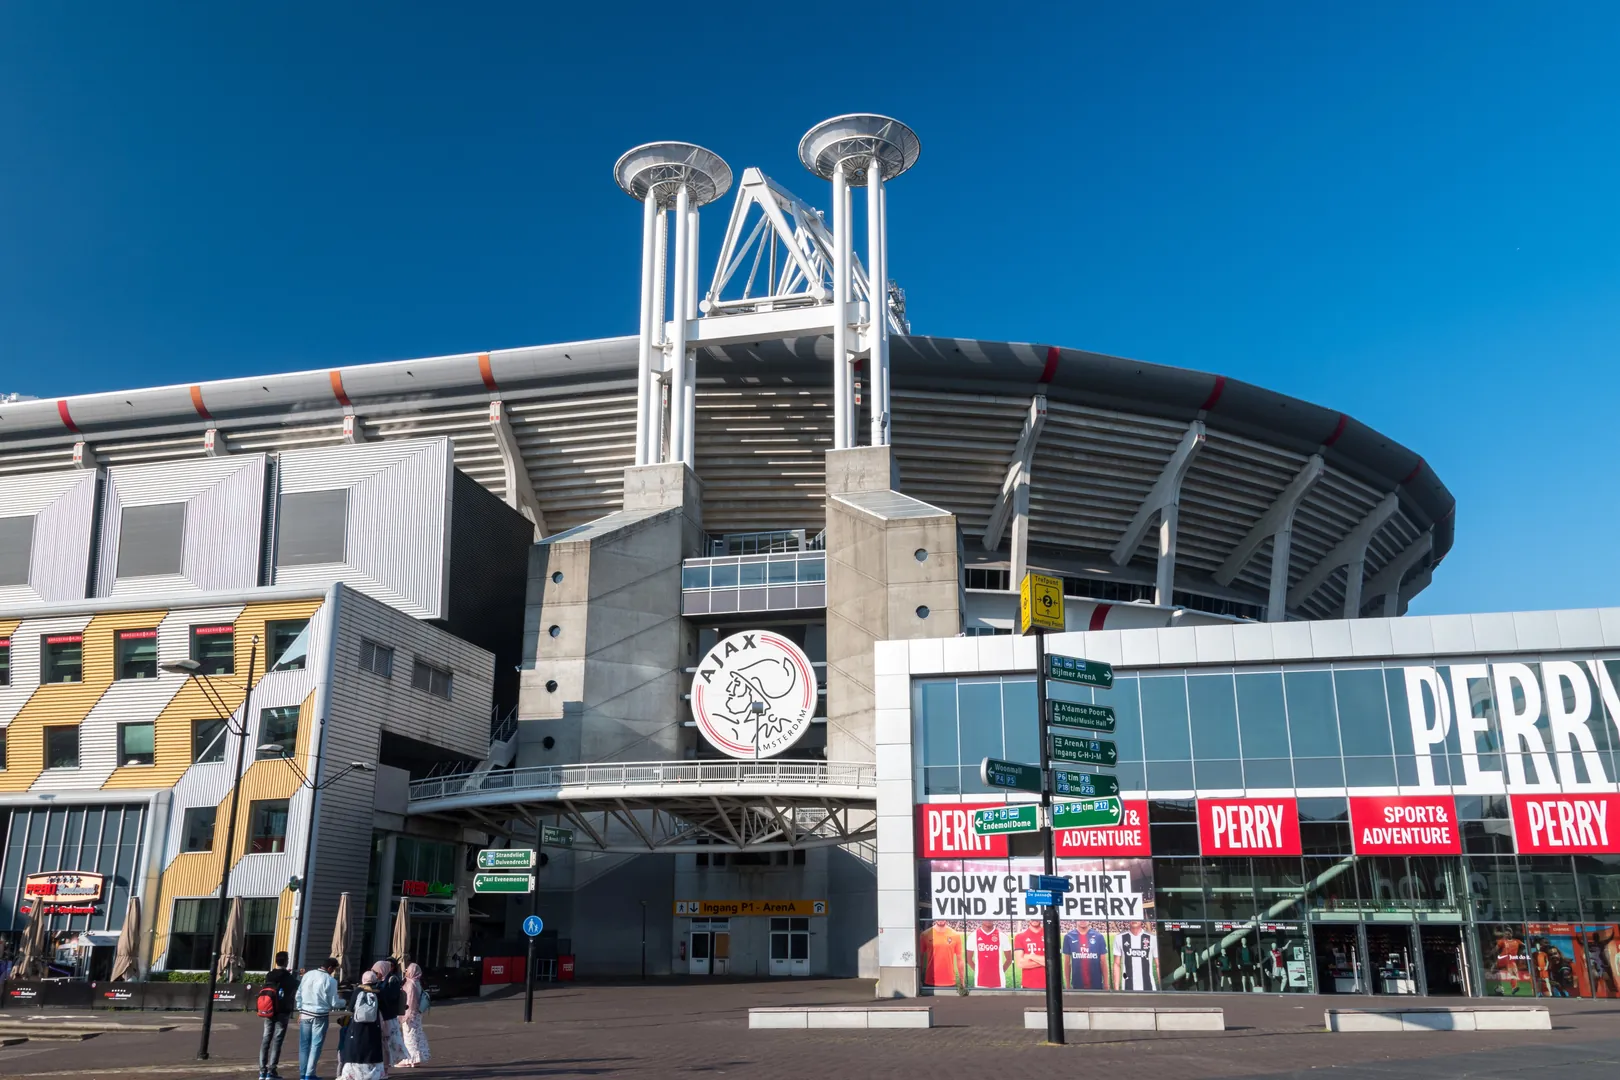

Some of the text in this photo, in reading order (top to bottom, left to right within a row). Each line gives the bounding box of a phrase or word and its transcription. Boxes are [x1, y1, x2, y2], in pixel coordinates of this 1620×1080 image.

[1044, 596, 1050, 606] 2
[700, 634, 756, 684] AJAX
[1052, 668, 1075, 677] Bijlmer
[1062, 705, 1106, 716] A'damse Poort
[1064, 739, 1084, 747] ArenA
[1055, 748, 1077, 758] Ingang
[995, 763, 1022, 774] Woonmall
[984, 812, 993, 820] P2
[1384, 806, 1448, 823] SPORT&
[983, 820, 1031, 830] Endemol/Dome
[1211, 804, 1284, 848] PERRY
[1526, 800, 1609, 846] PERRY
[1062, 830, 1142, 847] ADVENTURE
[1363, 827, 1451, 844] ADVENTURE
[935, 875, 998, 893] JOUW
[704, 903, 738, 914] Ingang
[742, 903, 753, 911] P1
[763, 903, 796, 911] ArenA
[936, 898, 986, 915] VIND
[993, 898, 1018, 915] JE
[1066, 897, 1138, 915] PERRY
[978, 943, 998, 952] Ziggo
[1126, 949, 1146, 957] Jeep
